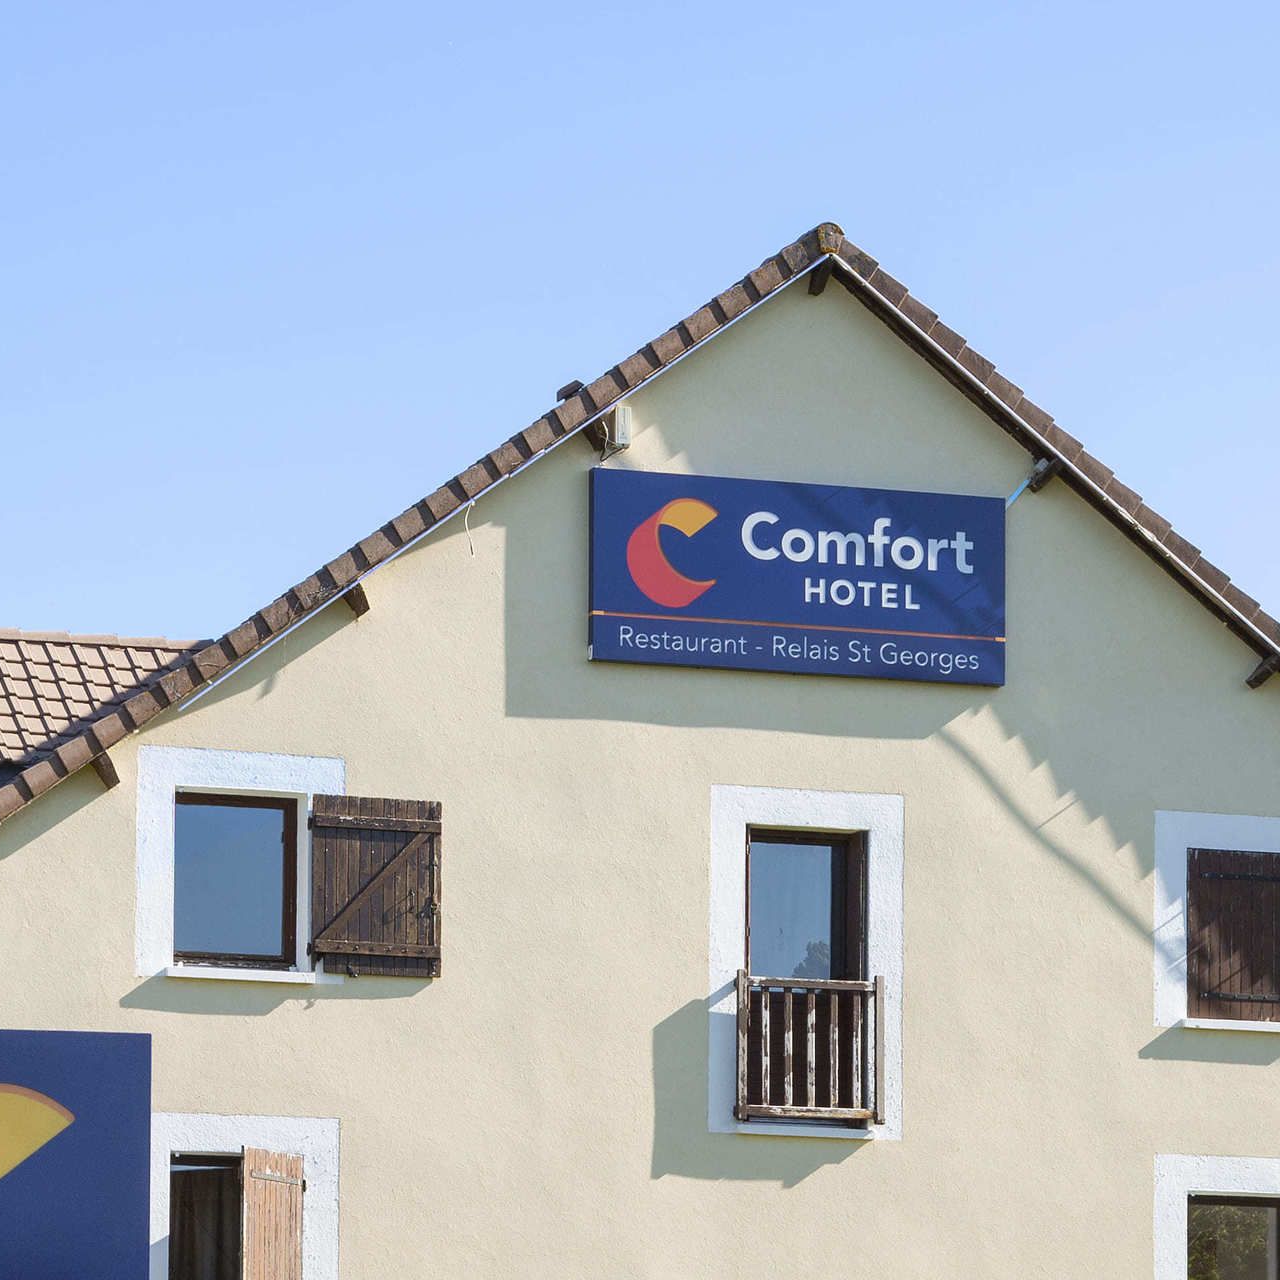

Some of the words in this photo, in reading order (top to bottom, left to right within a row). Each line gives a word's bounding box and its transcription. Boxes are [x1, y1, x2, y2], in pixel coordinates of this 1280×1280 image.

[741, 511, 974, 574] Comfort
[804, 577, 921, 610] HOTEL
[619, 625, 748, 655] Restaurant
[772, 635, 840, 661] Relais
[848, 640, 872, 663] St
[879, 642, 980, 675] Georges
